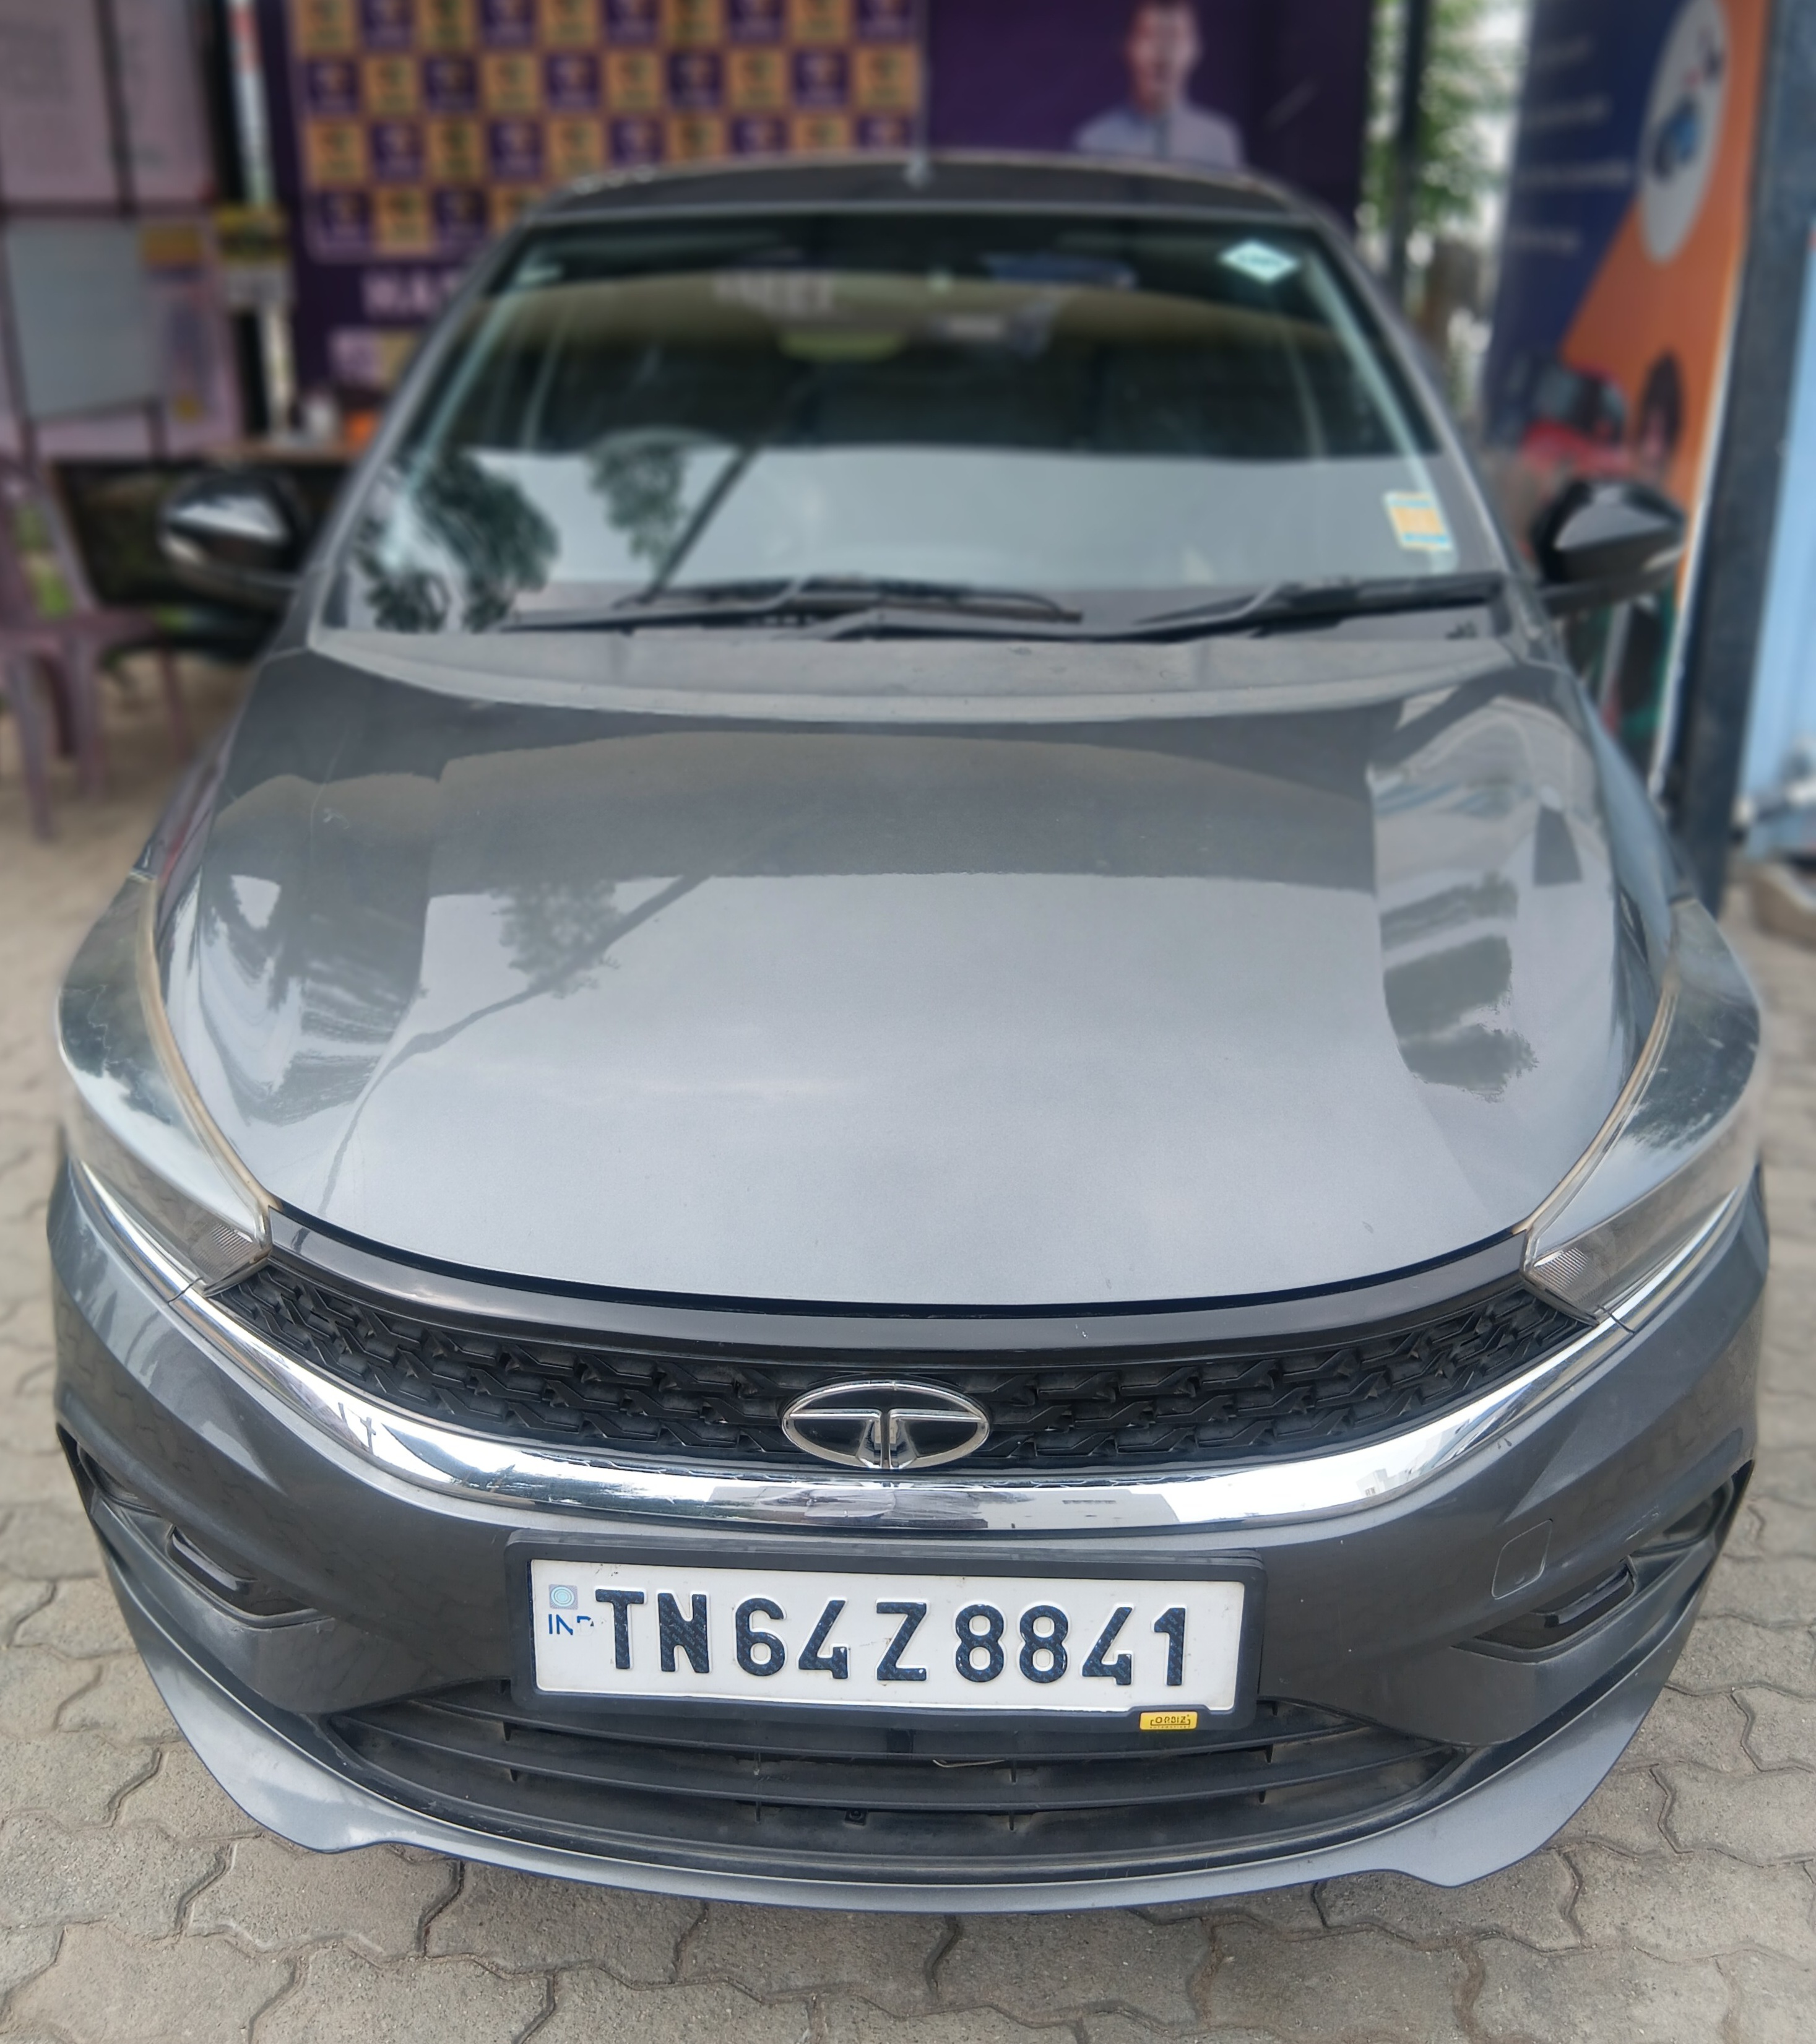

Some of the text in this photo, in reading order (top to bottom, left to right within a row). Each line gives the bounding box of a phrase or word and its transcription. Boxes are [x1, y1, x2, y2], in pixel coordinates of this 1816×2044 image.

[595, 1588, 1186, 1686] TN 64 Z 8841
[1155, 1716, 1187, 1724] ORBIZ
